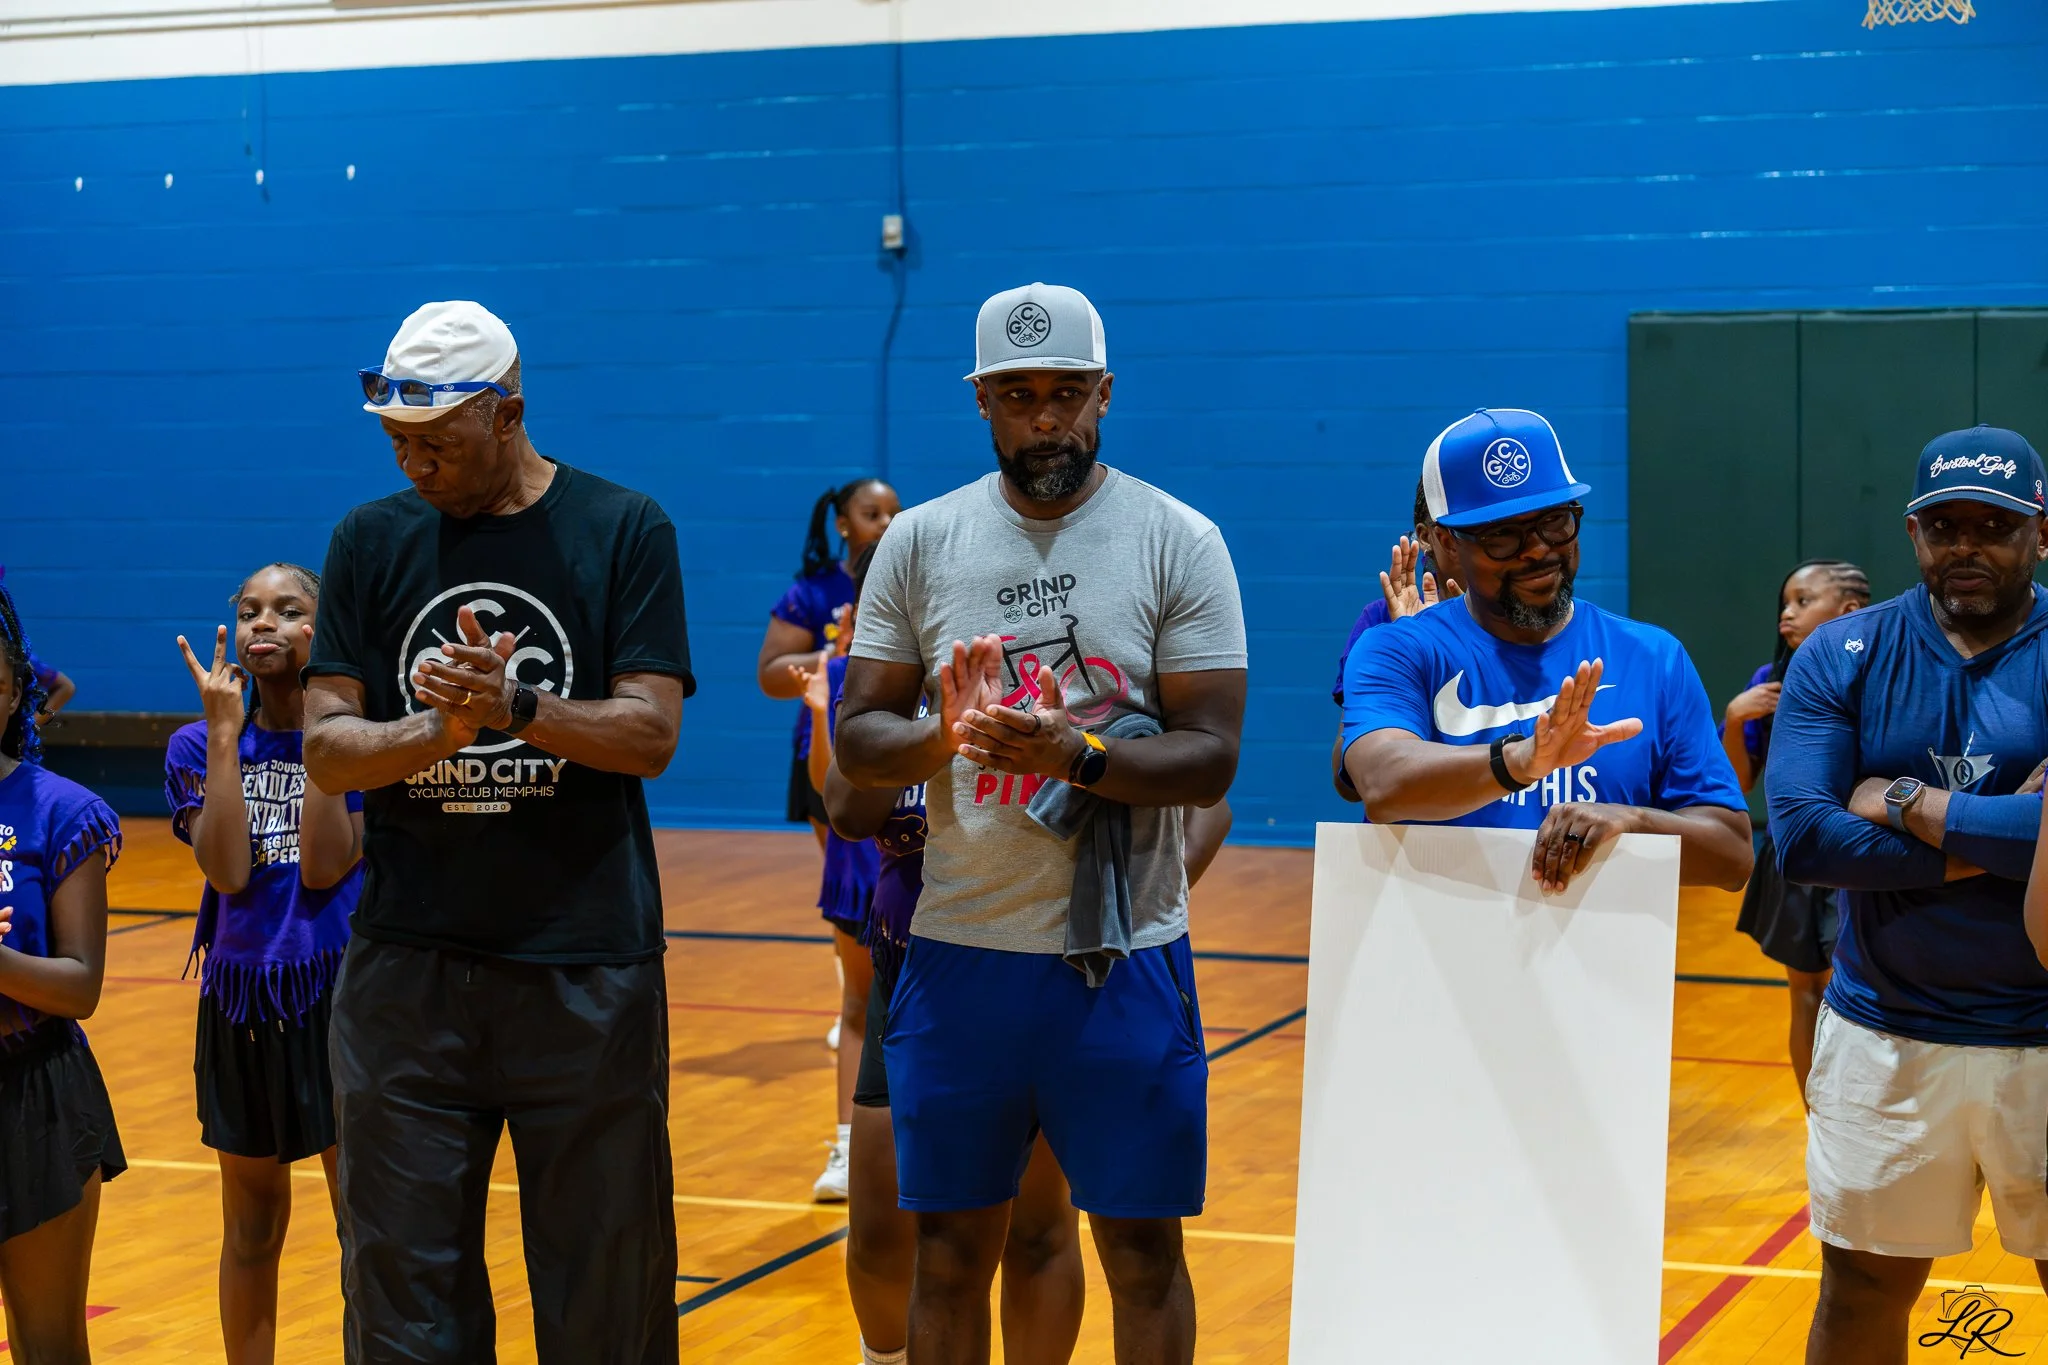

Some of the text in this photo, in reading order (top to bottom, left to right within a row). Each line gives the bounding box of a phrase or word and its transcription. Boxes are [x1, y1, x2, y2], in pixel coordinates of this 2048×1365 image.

[1930, 453, 2017, 480] Barstool Golf
[996, 573, 1077, 606] GRIND
[1026, 591, 1070, 617] CITY
[242, 761, 269, 774] YOUR
[490, 758, 568, 784] CITY
[408, 785, 555, 799] CYCLING CLUB MEMPHIS
[1502, 765, 1598, 807] PHIS
[447, 803, 506, 812] EST. 2020
[263, 832, 300, 852] BEGIN
